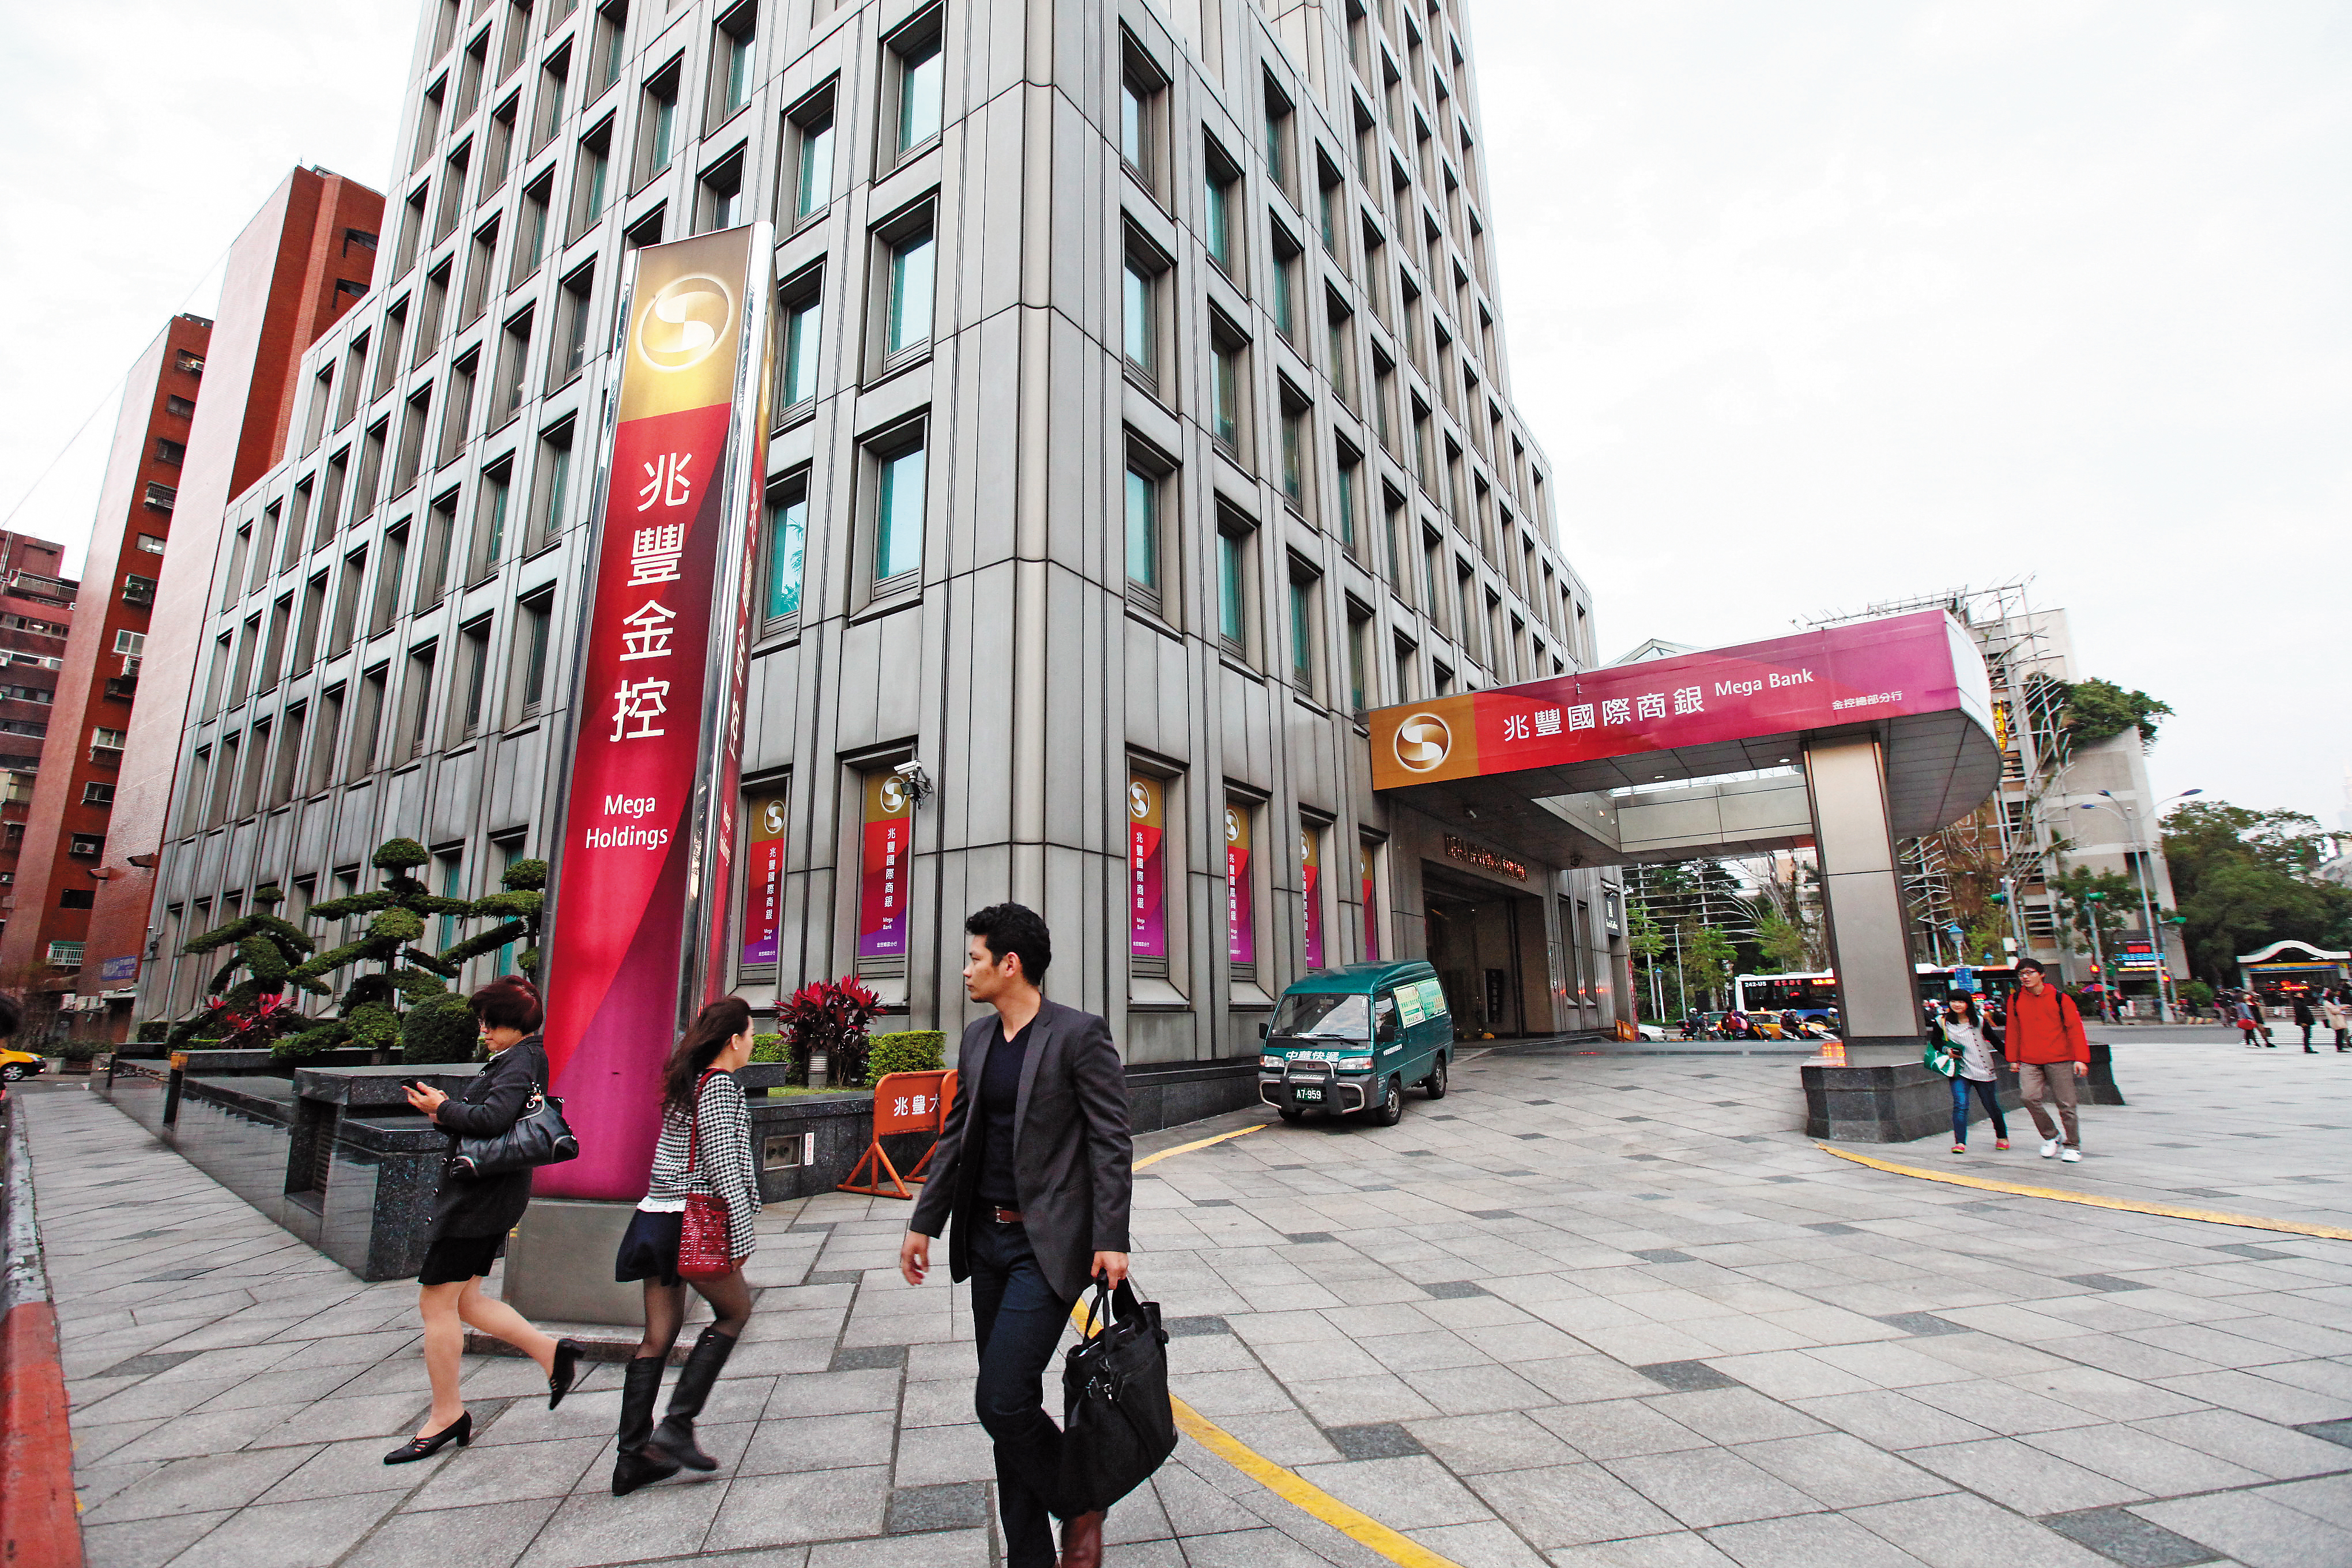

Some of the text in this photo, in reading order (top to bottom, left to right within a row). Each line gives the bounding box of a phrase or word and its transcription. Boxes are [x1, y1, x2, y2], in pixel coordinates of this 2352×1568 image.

[610, 452, 693, 742] 兆豐金控
[1715, 669, 1814, 696] Mega Bank
[1503, 685, 1705, 742] 兆豐國際商銀
[1832, 691, 1902, 710] 金控總部分行
[604, 794, 655, 819] Mega
[586, 825, 668, 850] Holdings
[884, 828, 896, 907] 兆豐國際商銀
[766, 847, 777, 919] 兆豐國際商銀
[1286, 1051, 1340, 1060] 中華快遞
[1296, 1089, 1321, 1099] A7-959
